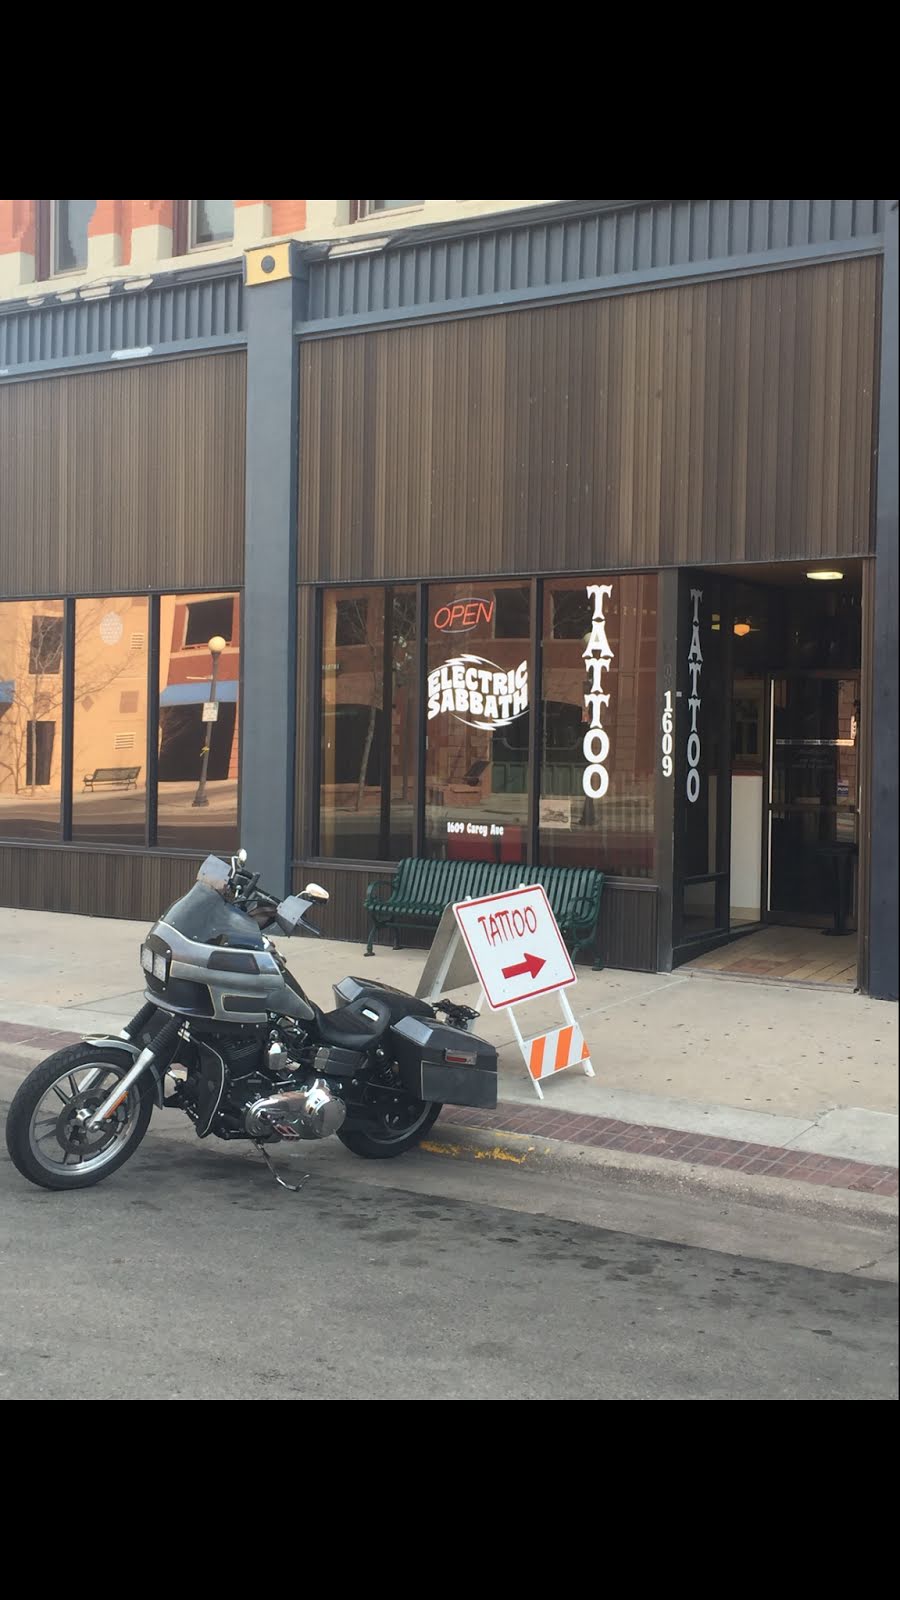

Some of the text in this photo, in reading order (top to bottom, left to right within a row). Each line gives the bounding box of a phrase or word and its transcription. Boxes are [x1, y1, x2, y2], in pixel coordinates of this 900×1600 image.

[434, 600, 494, 630] OPEN
[427, 660, 529, 698] ELECTRIC
[582, 584, 614, 799] TATTOO
[686, 588, 704, 803] TATTOO
[427, 683, 529, 720] SABBATH
[661, 690, 673, 777] 1609
[446, 821, 504, 837] 1609 Carey Ave
[477, 905, 538, 947] TATTOO
